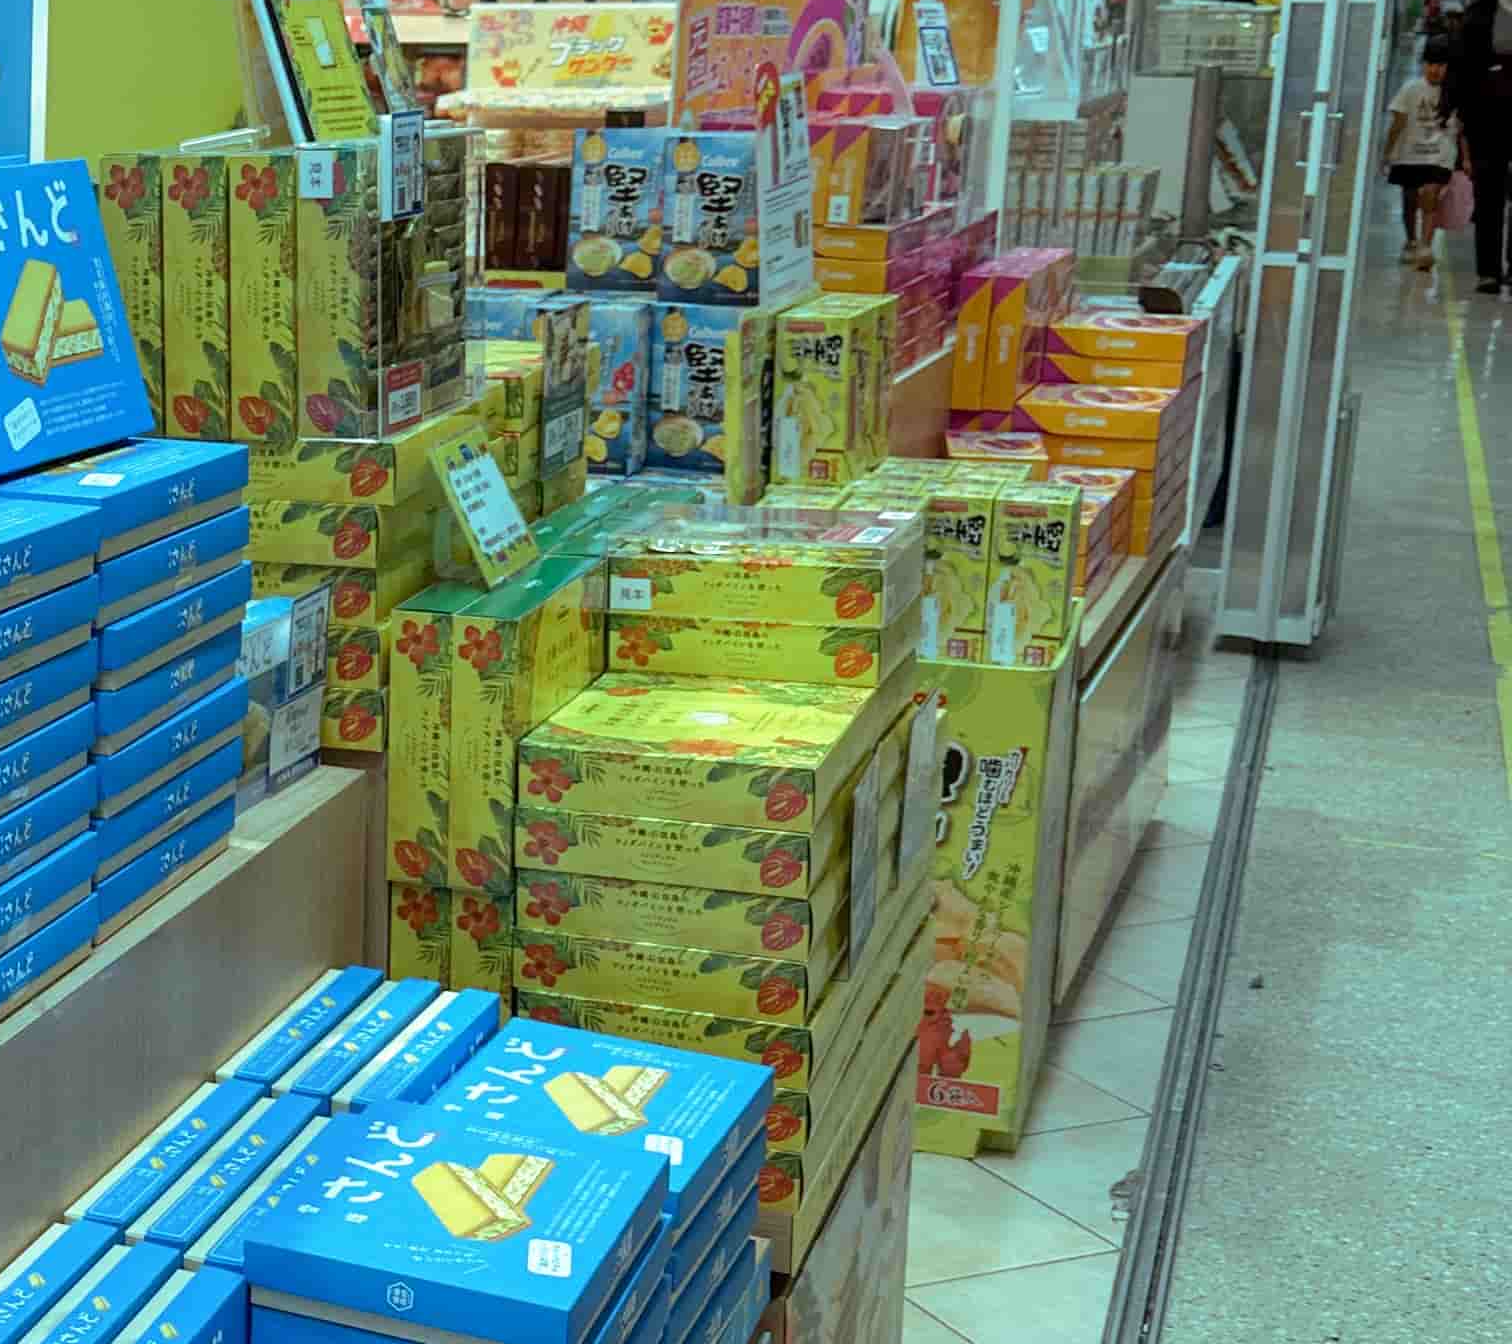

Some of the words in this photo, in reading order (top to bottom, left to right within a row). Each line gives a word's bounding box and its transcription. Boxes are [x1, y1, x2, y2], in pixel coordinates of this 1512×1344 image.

[463, 1037, 567, 1107] さんど
[322, 1119, 439, 1205] さんど
